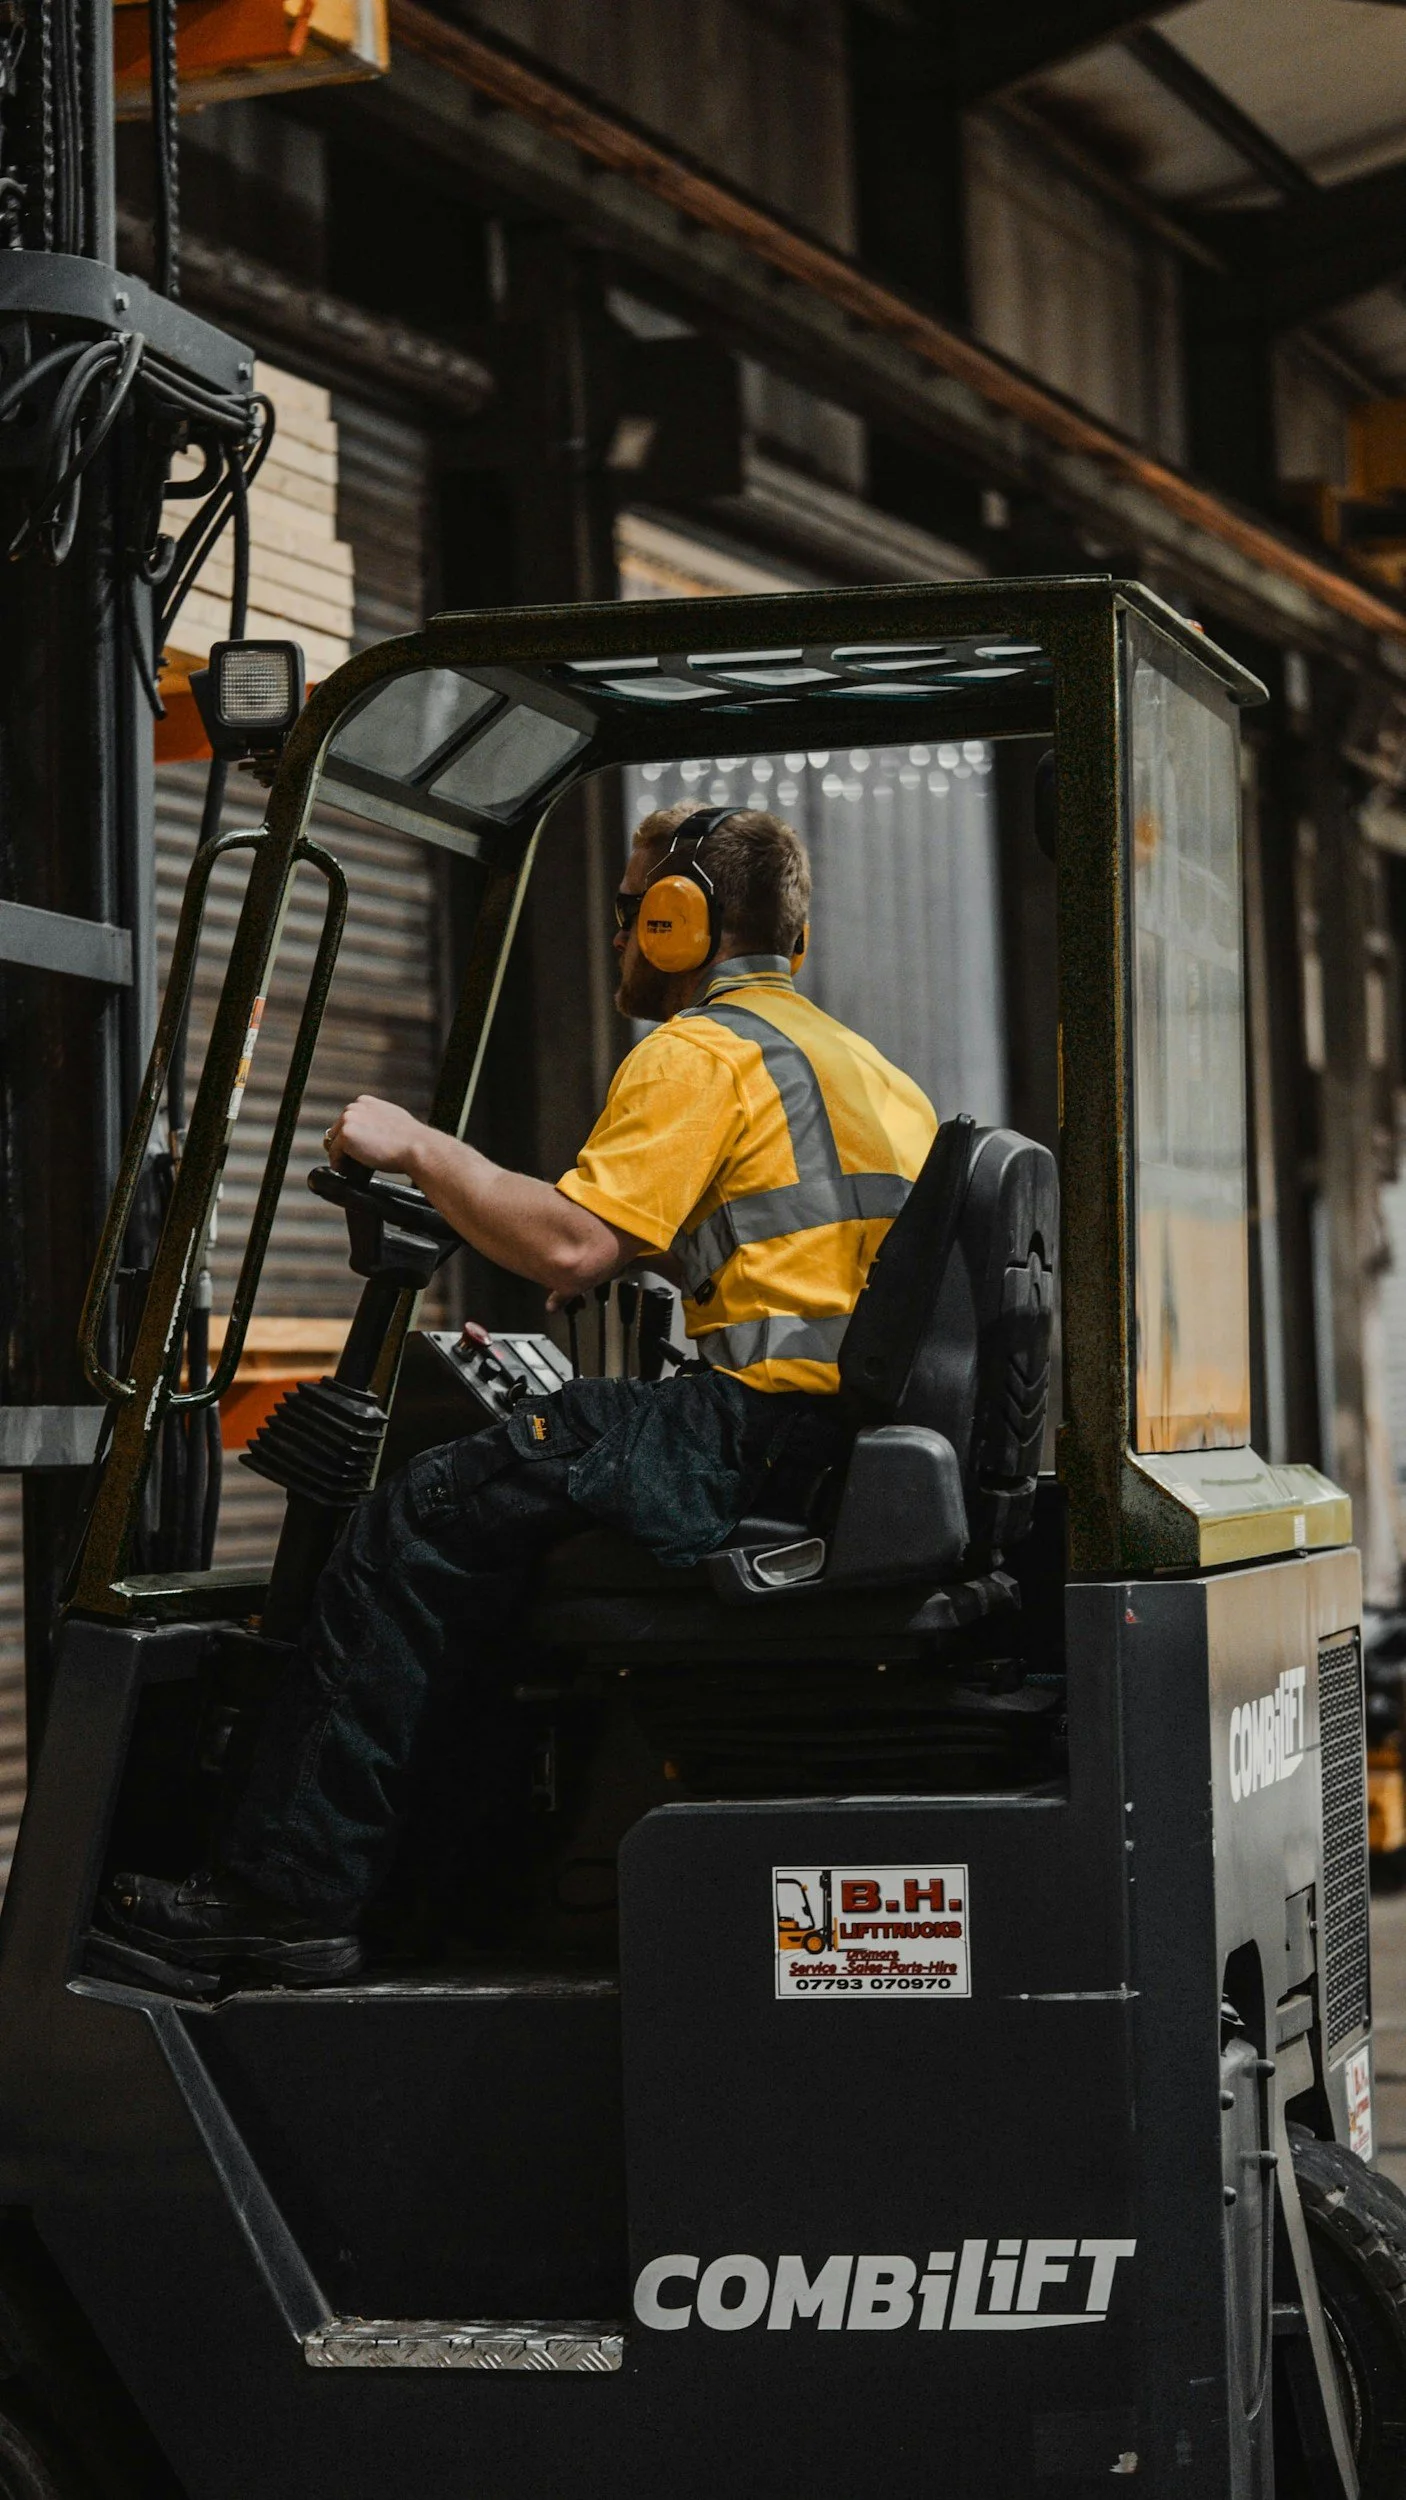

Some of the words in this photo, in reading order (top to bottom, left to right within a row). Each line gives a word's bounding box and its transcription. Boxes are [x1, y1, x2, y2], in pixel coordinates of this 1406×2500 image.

[841, 1878, 962, 1913] B.H.
[840, 1921, 962, 1939] LIFTTRUCKS
[846, 1950, 900, 1961] Dromore
[789, 1961, 837, 1975] Service
[796, 1979, 863, 1990] 07793
[870, 1978, 951, 1989] 070970
